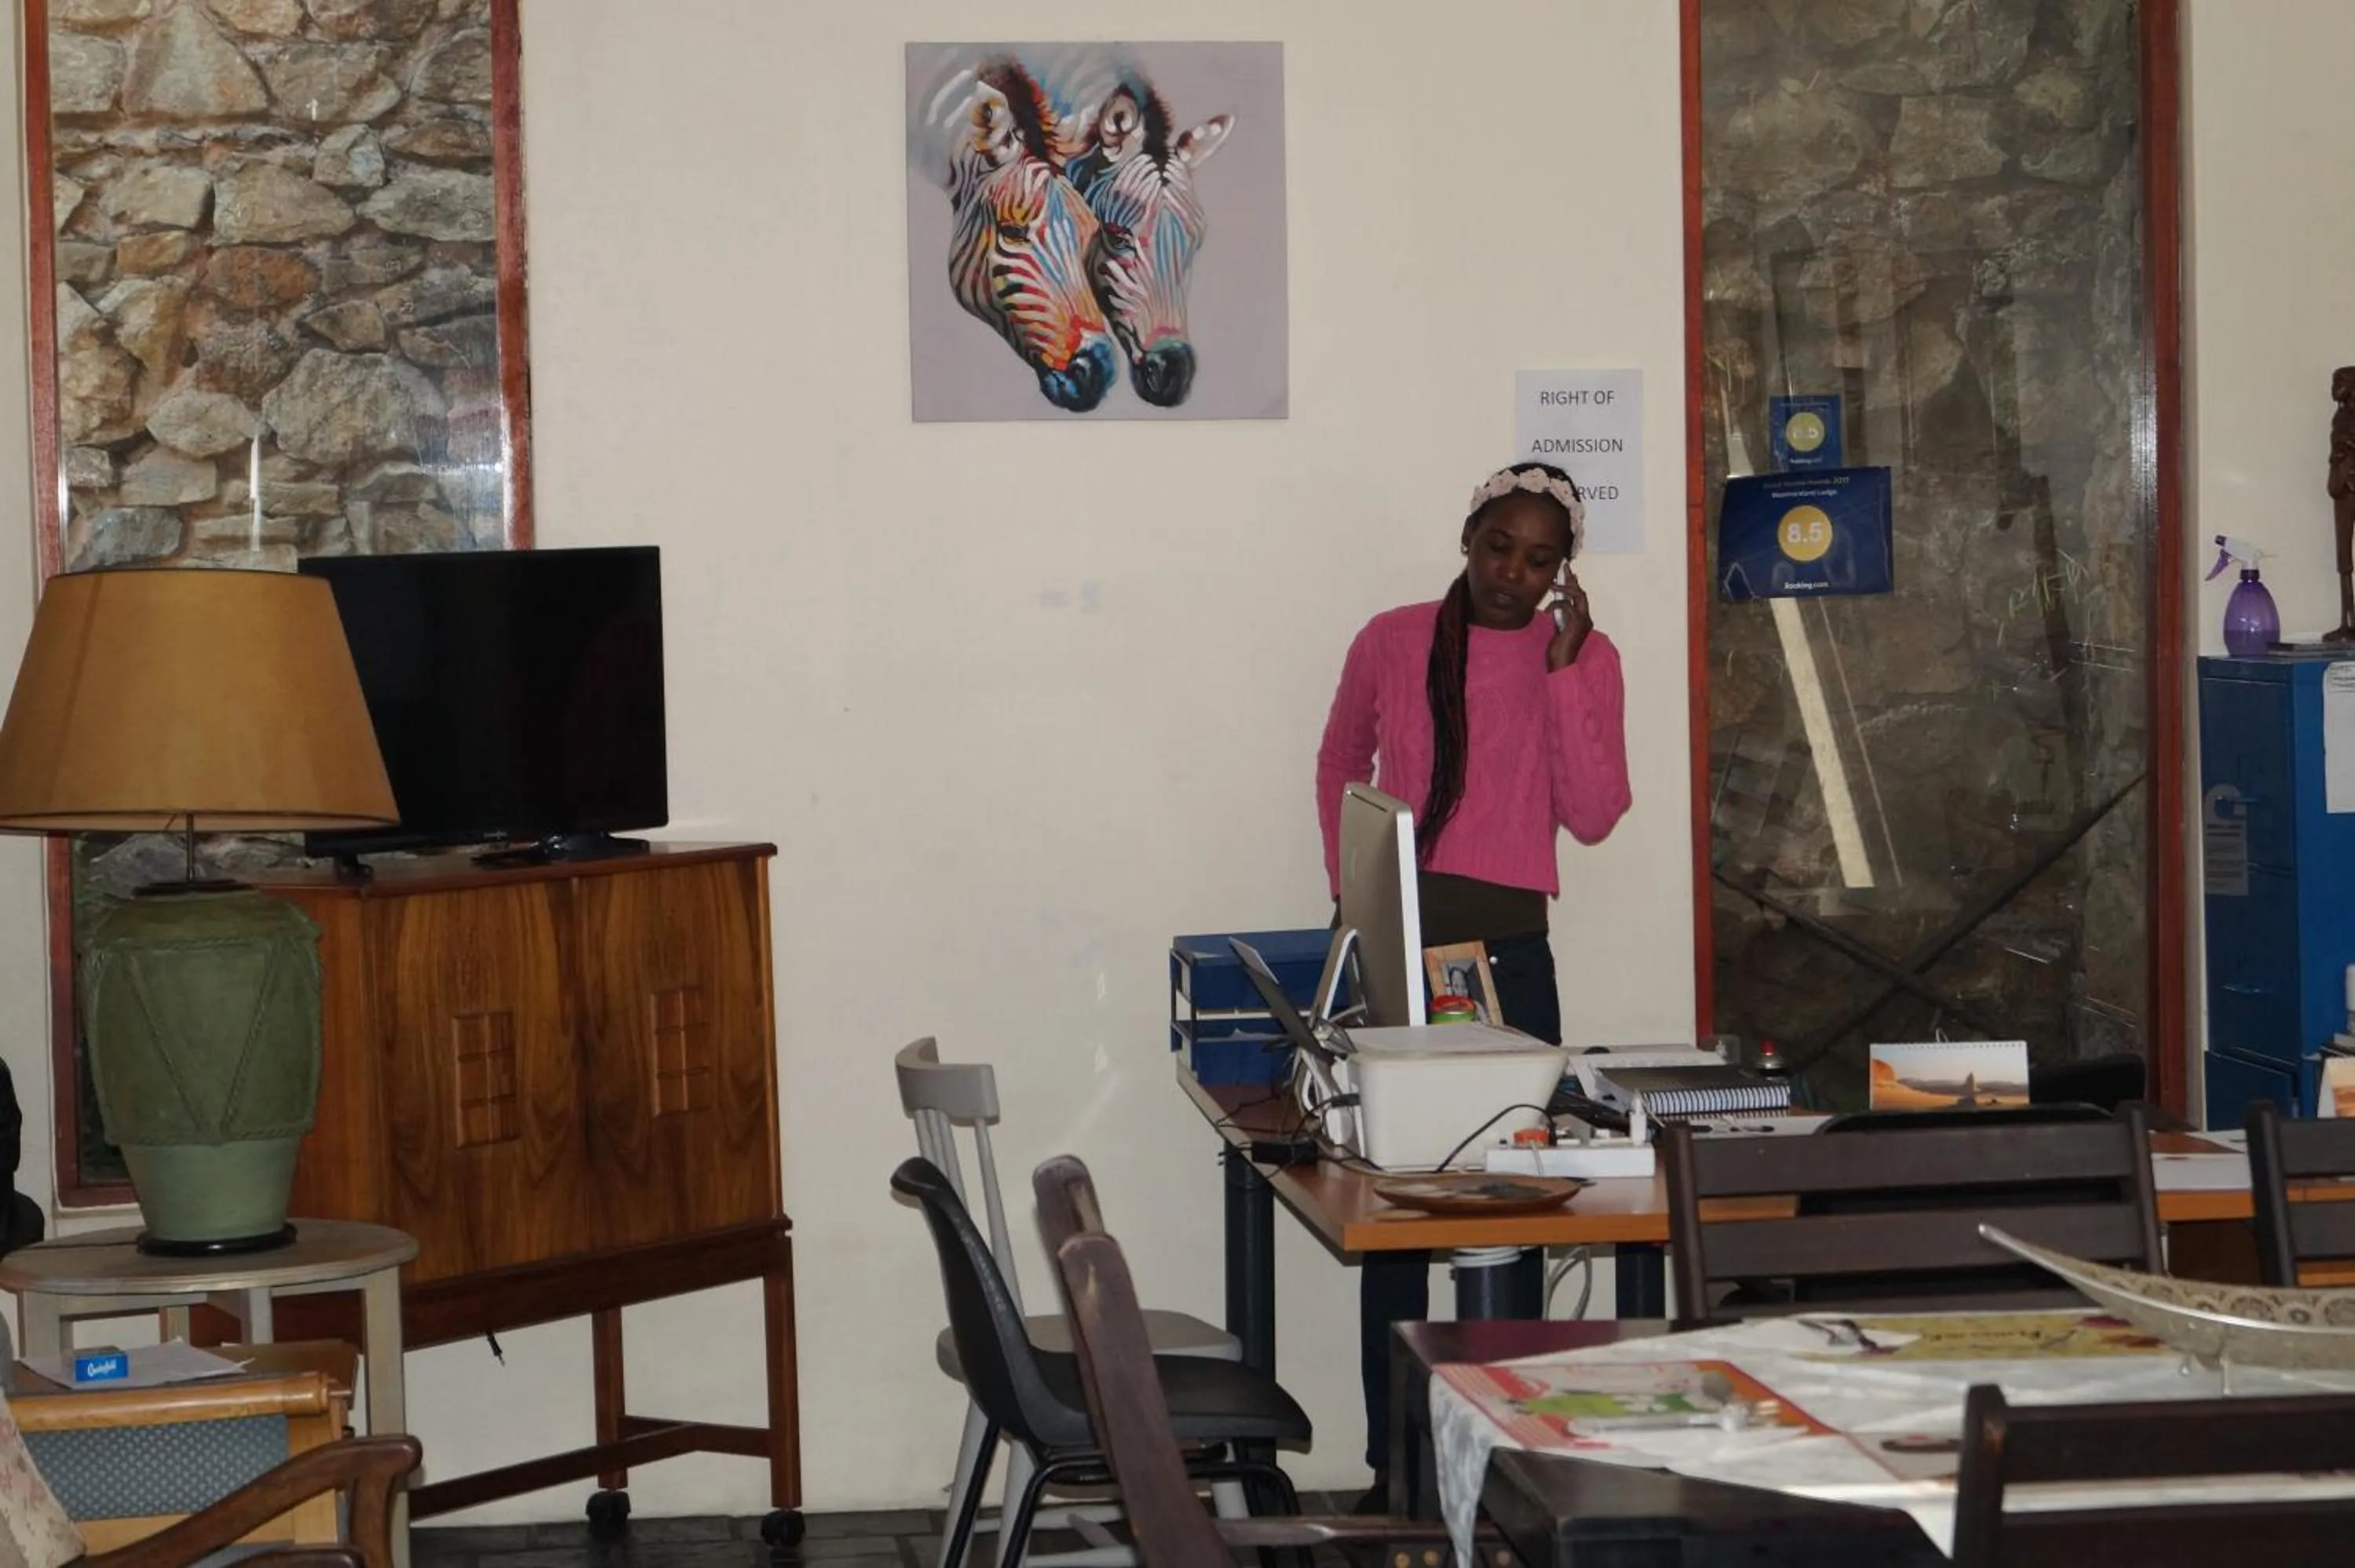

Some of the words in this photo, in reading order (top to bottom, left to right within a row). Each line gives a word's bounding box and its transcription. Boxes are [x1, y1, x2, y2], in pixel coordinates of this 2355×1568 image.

[1540, 391, 1589, 405] RIGHT
[1594, 391, 1615, 404] OF
[1532, 439, 1623, 453] ADMISSION
[1577, 486, 1619, 500] RVED
[1787, 521, 1823, 543] 8.5
